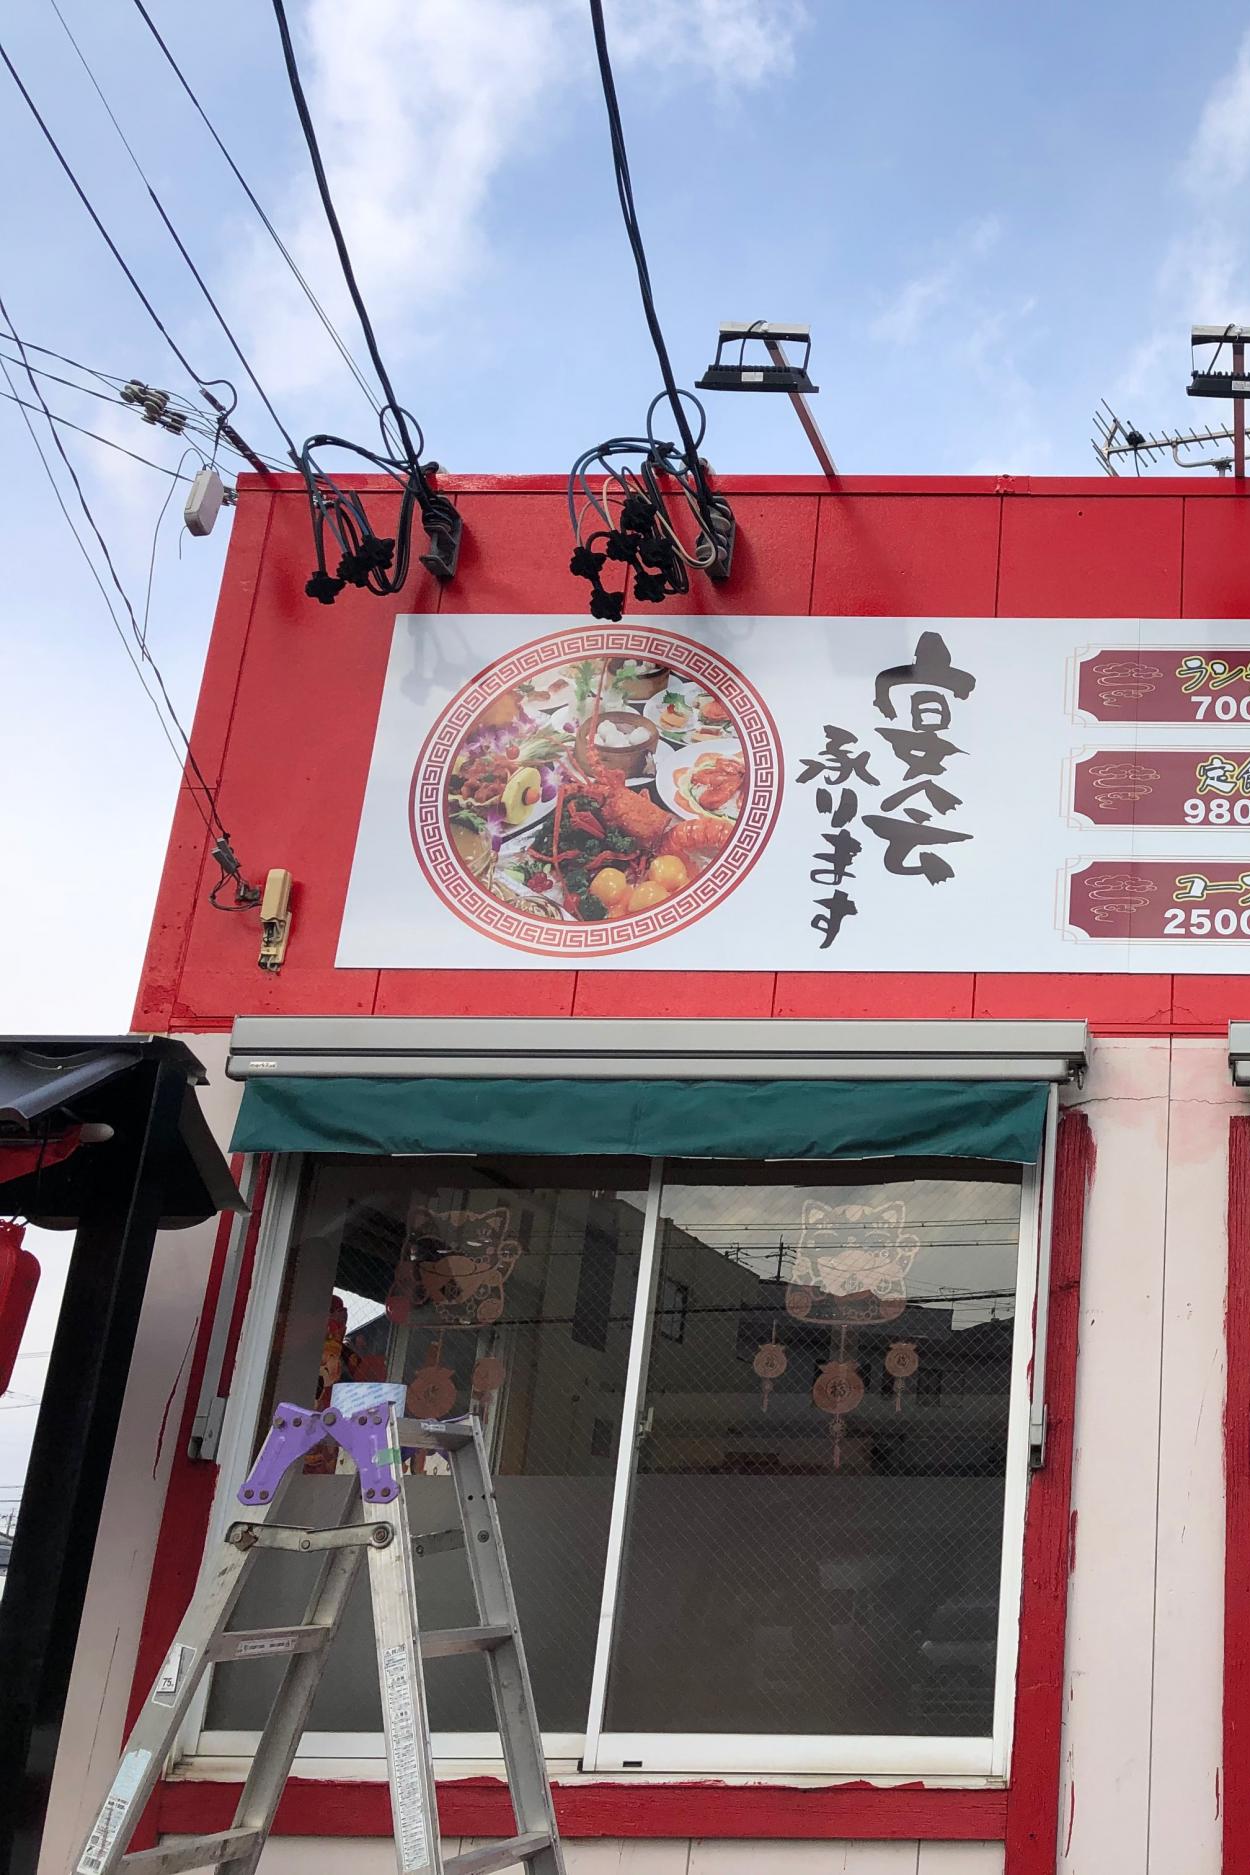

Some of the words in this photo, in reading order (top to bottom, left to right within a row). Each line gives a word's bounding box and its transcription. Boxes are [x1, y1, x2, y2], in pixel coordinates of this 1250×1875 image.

[795, 724, 881, 950] 承ります
[861, 630, 977, 887] 宴会
